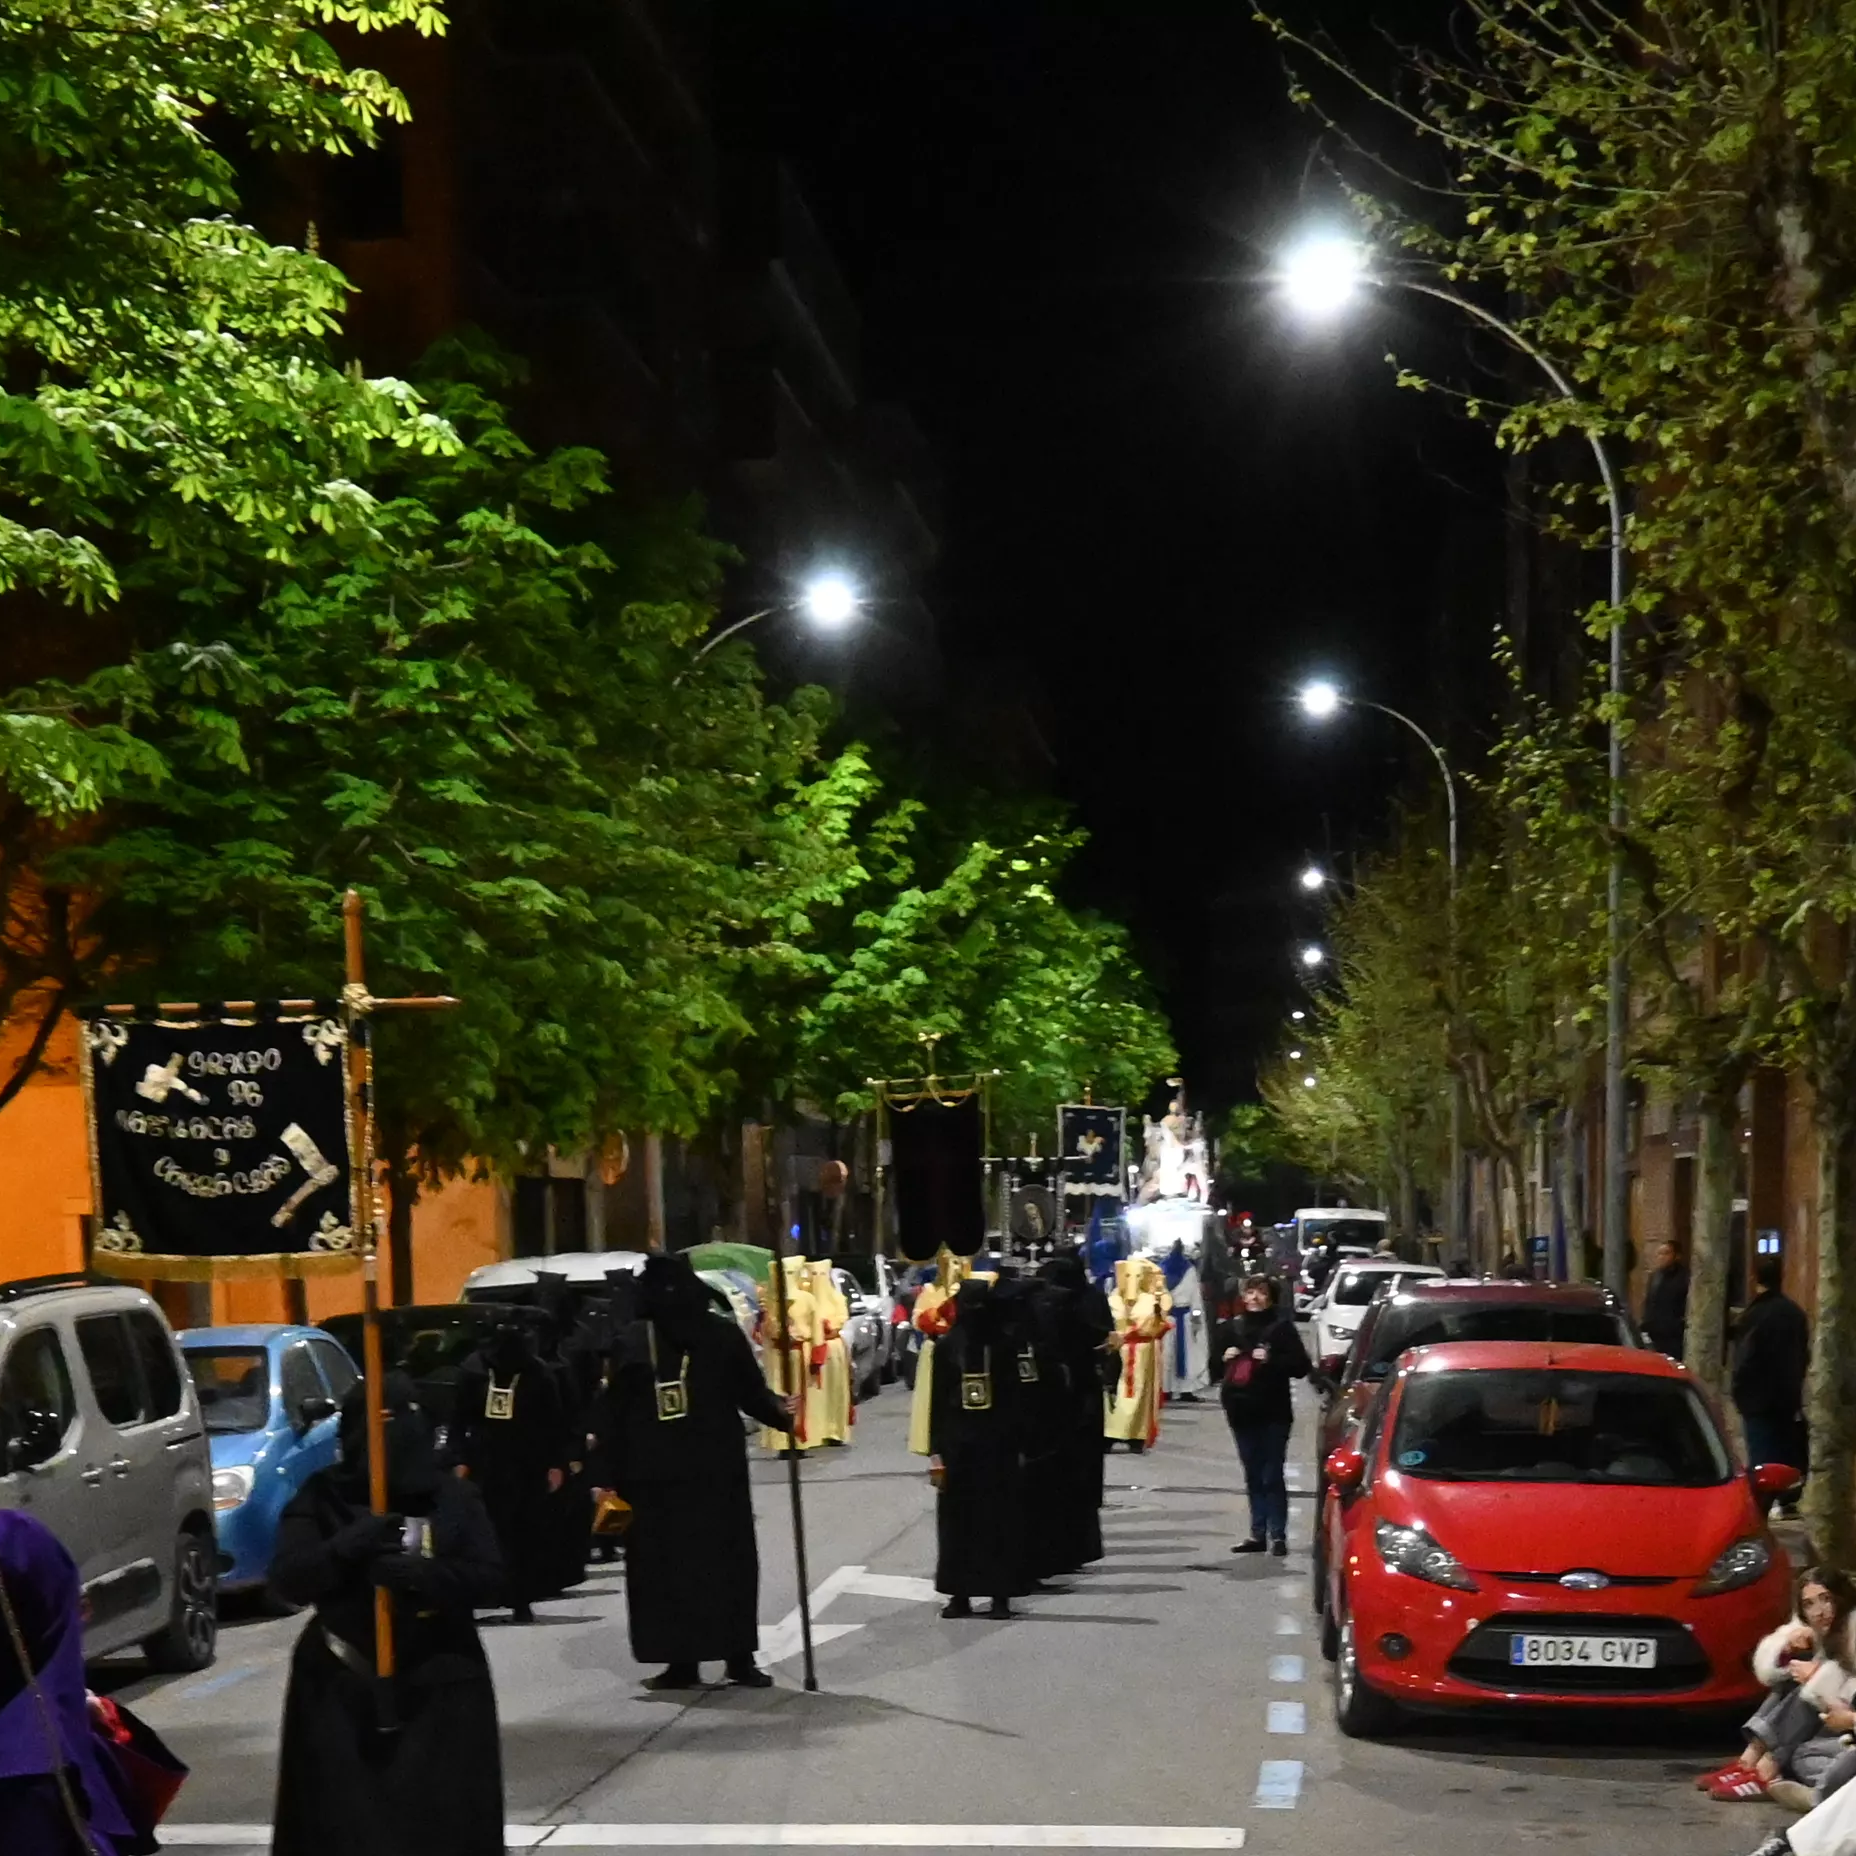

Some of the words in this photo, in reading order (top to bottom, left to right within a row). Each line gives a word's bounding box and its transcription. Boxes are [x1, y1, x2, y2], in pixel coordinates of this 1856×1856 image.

[187, 1047, 283, 1077] GRUPO
[1527, 1639, 1591, 1662] 8034
[1601, 1640, 1650, 1664] GVP
